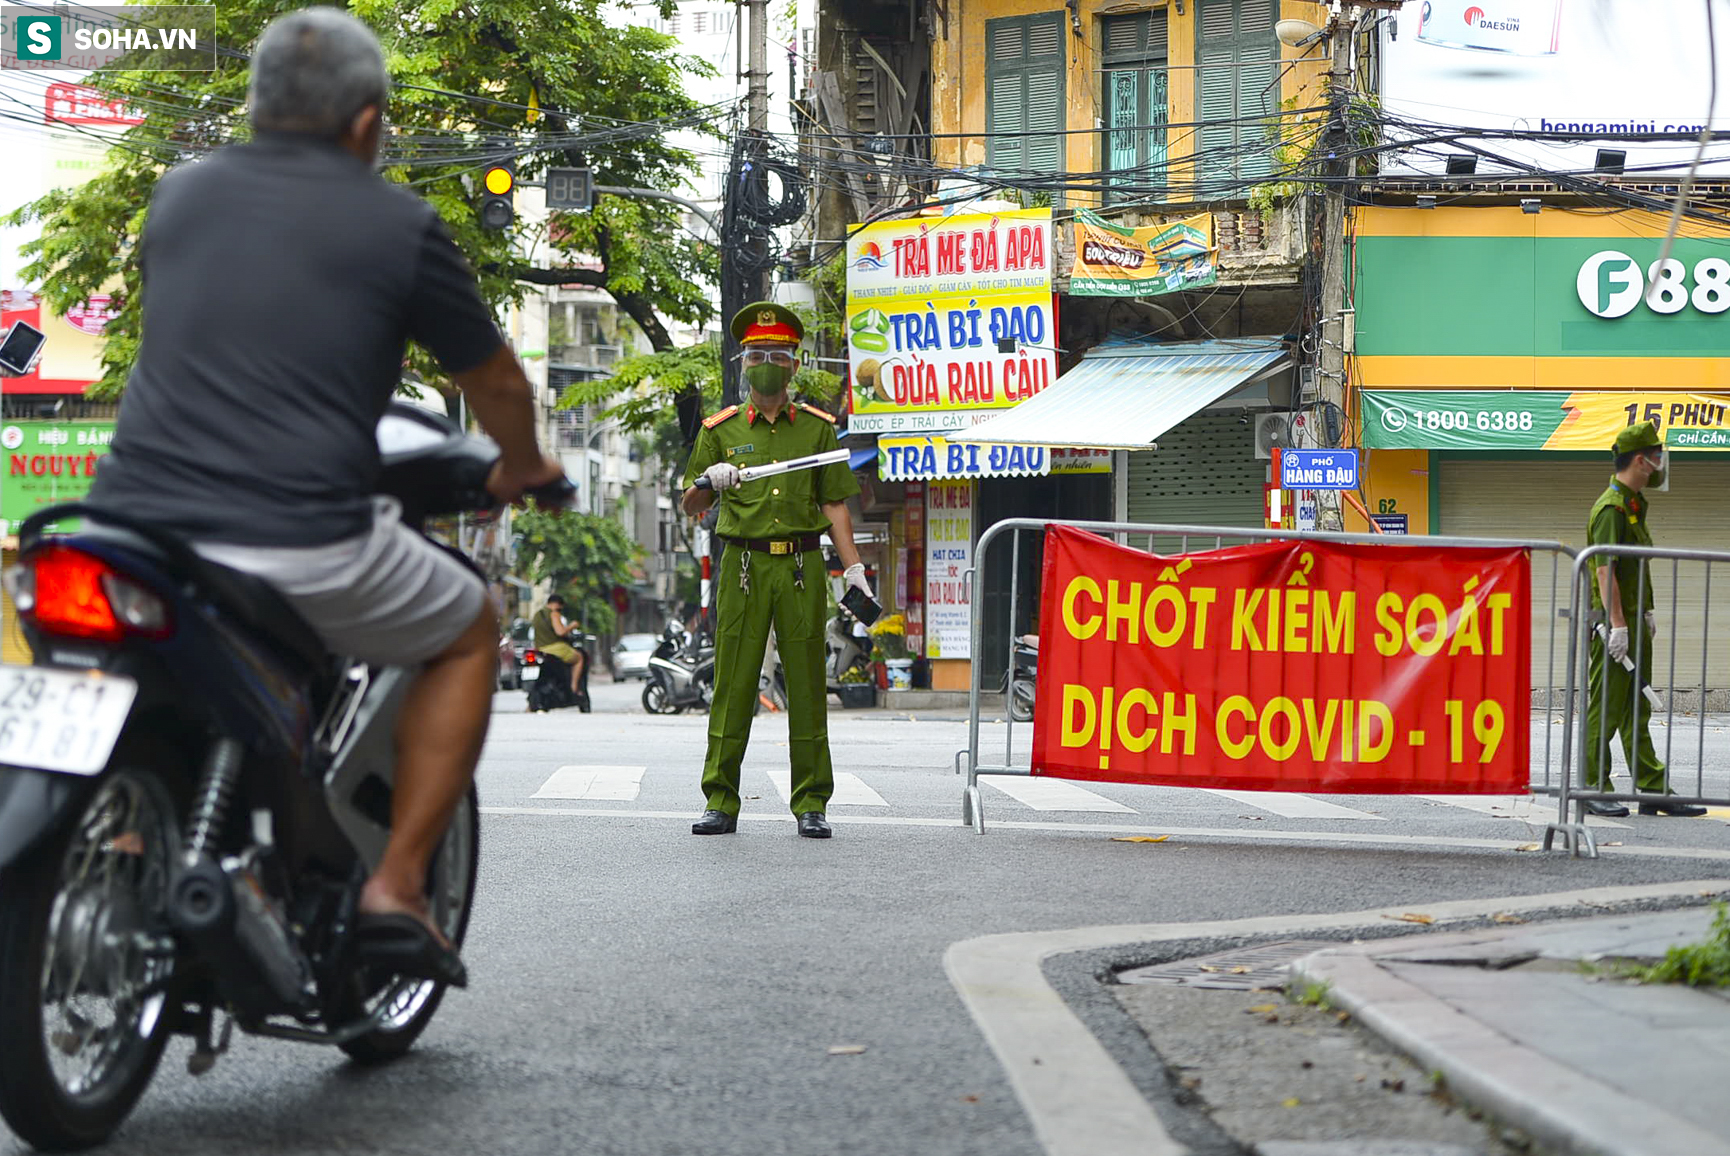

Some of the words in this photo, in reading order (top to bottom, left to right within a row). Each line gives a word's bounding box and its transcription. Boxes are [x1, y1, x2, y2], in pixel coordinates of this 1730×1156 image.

[1480, 20, 1520, 32] DAESUN
[1541, 118, 1709, 134] bengaminicom
[892, 222, 930, 279] TRÀ
[937, 230, 966, 276] ME
[971, 216, 999, 273] ĐÁ
[1004, 224, 1046, 271] APA
[889, 301, 942, 351] TRÀ
[947, 299, 983, 349] BÍ
[988, 304, 1046, 347] ĐAO
[892, 353, 941, 406] DỪA
[947, 360, 995, 404] RAU
[853, 417, 884, 431] NƯỚC
[891, 415, 905, 429] ÉP
[911, 413, 935, 428] TRÁI
[942, 412, 965, 427] CÂY
[1413, 410, 1469, 431] 1800
[1476, 411, 1533, 431] 6388
[1668, 400, 1728, 426] PHÚT
[10, 450, 98, 477] NGUYÊ
[887, 437, 938, 475] TRÀ
[1311, 455, 1335, 466] PHỐ
[1286, 466, 1323, 484] HÀNG
[1326, 467, 1354, 486] ĐẬU
[1378, 498, 1397, 514] 62
[1062, 558, 1216, 650] CHỐT
[1231, 552, 1357, 654] KIỂM
[1374, 574, 1511, 657] SOÁT
[1061, 683, 1197, 770] DỊCH
[1215, 694, 1394, 763] COVID
[1408, 729, 1426, 747] -
[1444, 700, 1506, 764] 19
